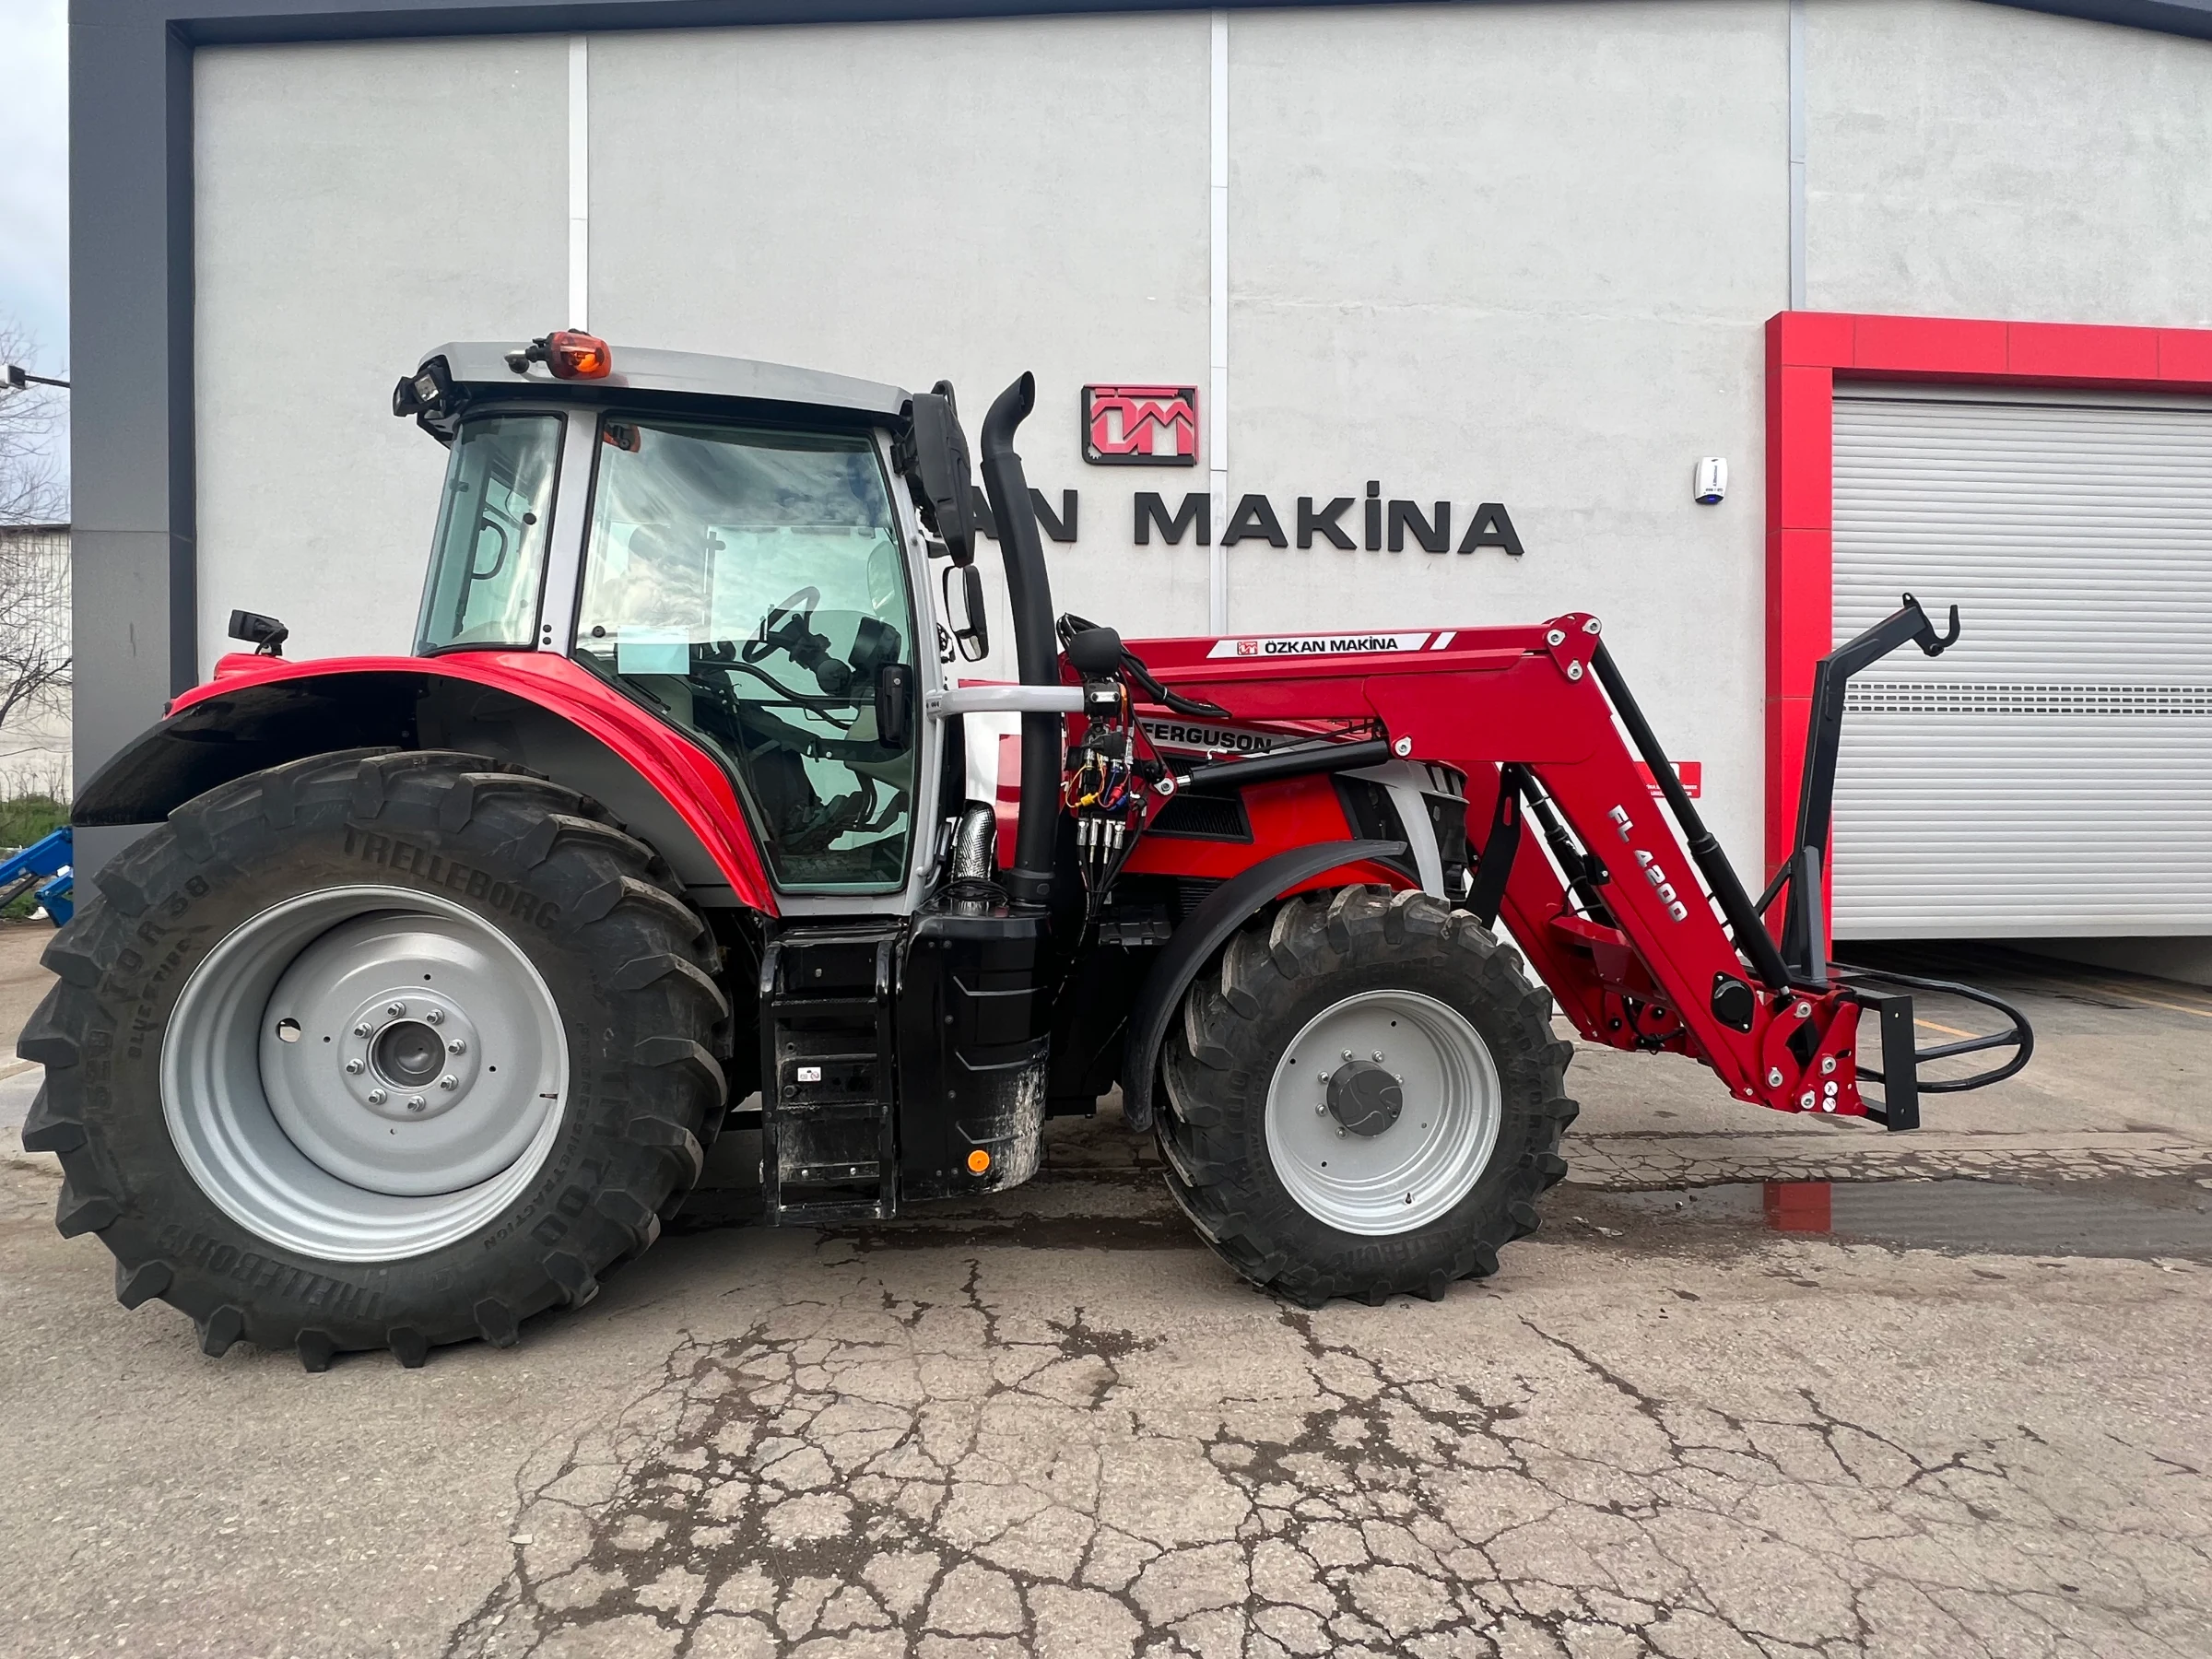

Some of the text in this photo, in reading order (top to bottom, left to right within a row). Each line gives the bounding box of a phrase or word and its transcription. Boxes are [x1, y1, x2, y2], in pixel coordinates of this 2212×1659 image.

[1134, 480, 1525, 556] MAKİNA
[1265, 636, 1399, 654] ÖZKAN MAKİNA
[1141, 722, 1273, 754] FERGUSON
[343, 822, 563, 931] TRELLEBORG
[1607, 804, 1688, 923] FL 4200
